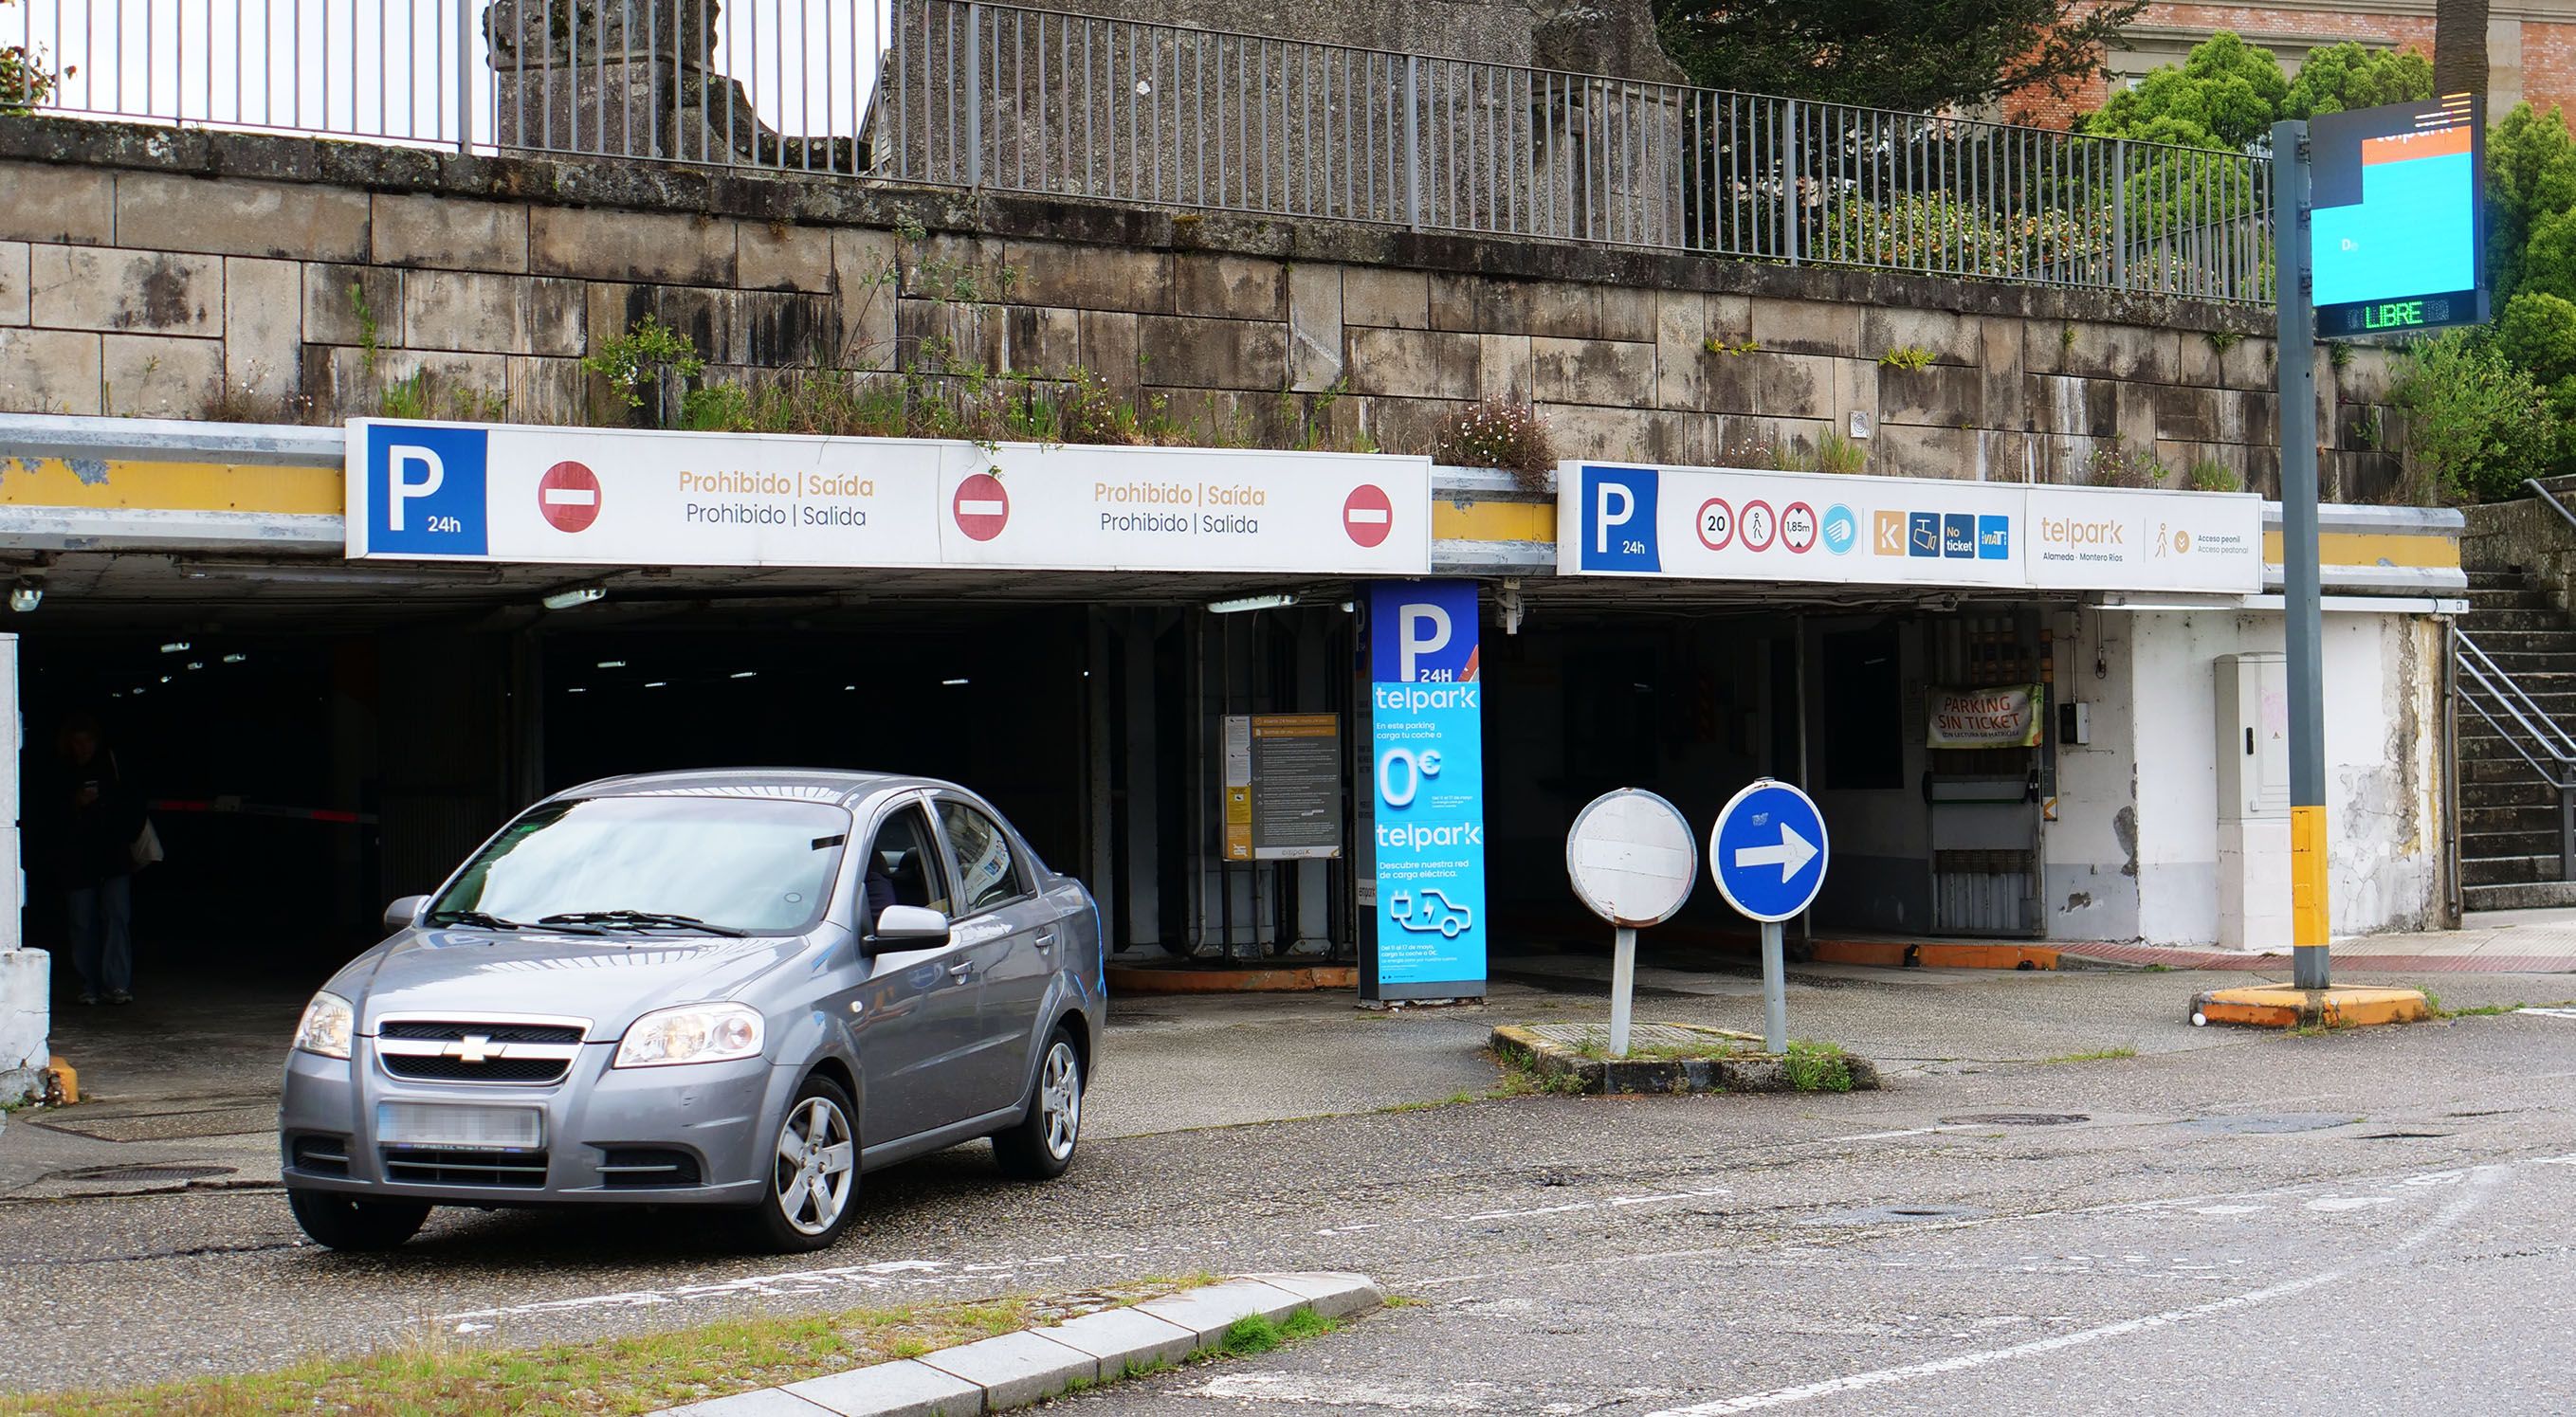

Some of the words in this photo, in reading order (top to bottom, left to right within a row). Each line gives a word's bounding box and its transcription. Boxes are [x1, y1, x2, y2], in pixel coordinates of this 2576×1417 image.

[2365, 300, 2423, 329] LIBRE
[388, 444, 445, 532] P
[679, 470, 792, 495] Prohibido
[809, 473, 874, 497] Saída
[1094, 482, 1193, 504] Prohibido
[1208, 484, 1266, 506] Saída
[686, 503, 787, 524] Prohibido
[803, 505, 867, 526] Salida
[1597, 481, 1635, 554] P
[428, 516, 462, 534] 24h
[1101, 513, 1188, 533] Prohibido
[1203, 515, 1259, 534] Salida
[1708, 515, 1726, 532] 20
[1786, 520, 1810, 533] 1,85m
[1946, 526, 1961, 538] No
[2041, 517, 2124, 550] telpark
[1622, 540, 1646, 554] 24h
[1946, 539, 1973, 553] ticket
[2198, 545, 2220, 554] Acceso
[2042, 552, 2074, 562] Alameda
[2079, 553, 2108, 562] Montero
[1399, 603, 1452, 682] P
[1420, 669, 1452, 682] 24H
[1376, 686, 1477, 715] telpark
[1944, 697, 2010, 713] PARKING
[1405, 722, 1435, 731] parking
[1938, 715, 1962, 729] SIN
[1964, 713, 2019, 730] TICKET
[1377, 733, 1400, 741] carga
[1379, 748, 1442, 807] 0€
[1377, 822, 1481, 852] telpark
[1379, 862, 1419, 870] Descubre
[1421, 860, 1452, 868] nuestra
[1393, 871, 1417, 881] carga
